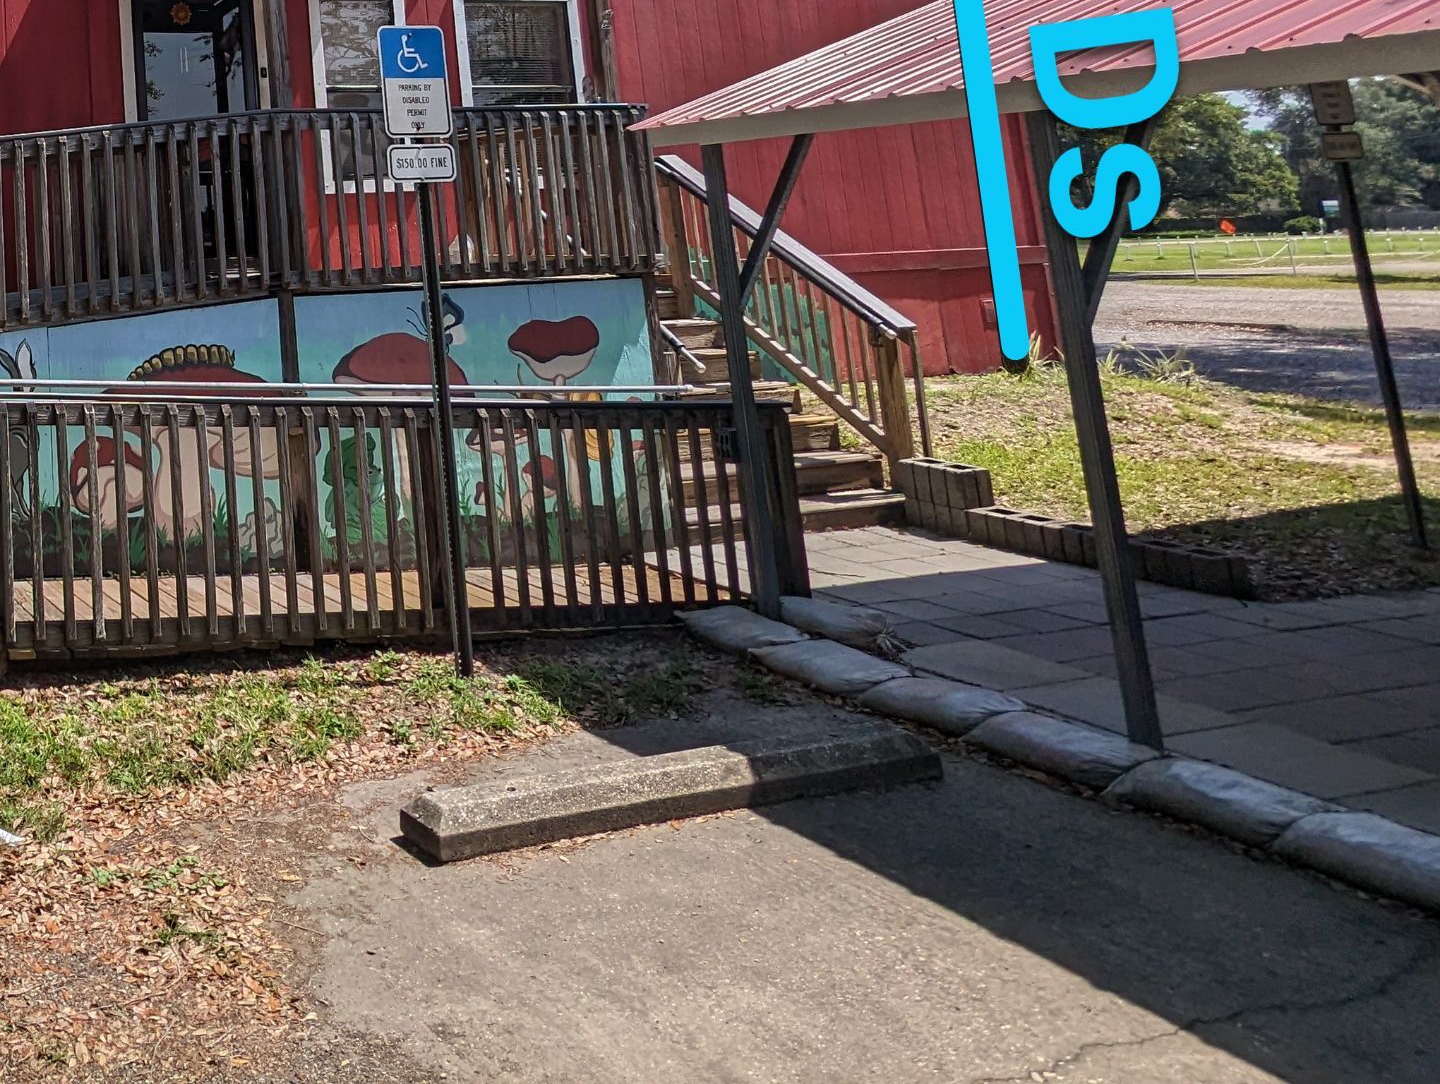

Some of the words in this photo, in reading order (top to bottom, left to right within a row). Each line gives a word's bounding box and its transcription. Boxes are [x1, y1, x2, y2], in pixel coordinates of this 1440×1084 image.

[397, 83, 422, 92] PARKING
[423, 83, 432, 92] BY
[402, 96, 430, 104] DISABLED
[406, 108, 427, 117] PERMIT
[410, 121, 425, 129] ONLY
[395, 157, 428, 169] $150.00
[430, 156, 449, 168] FINE
